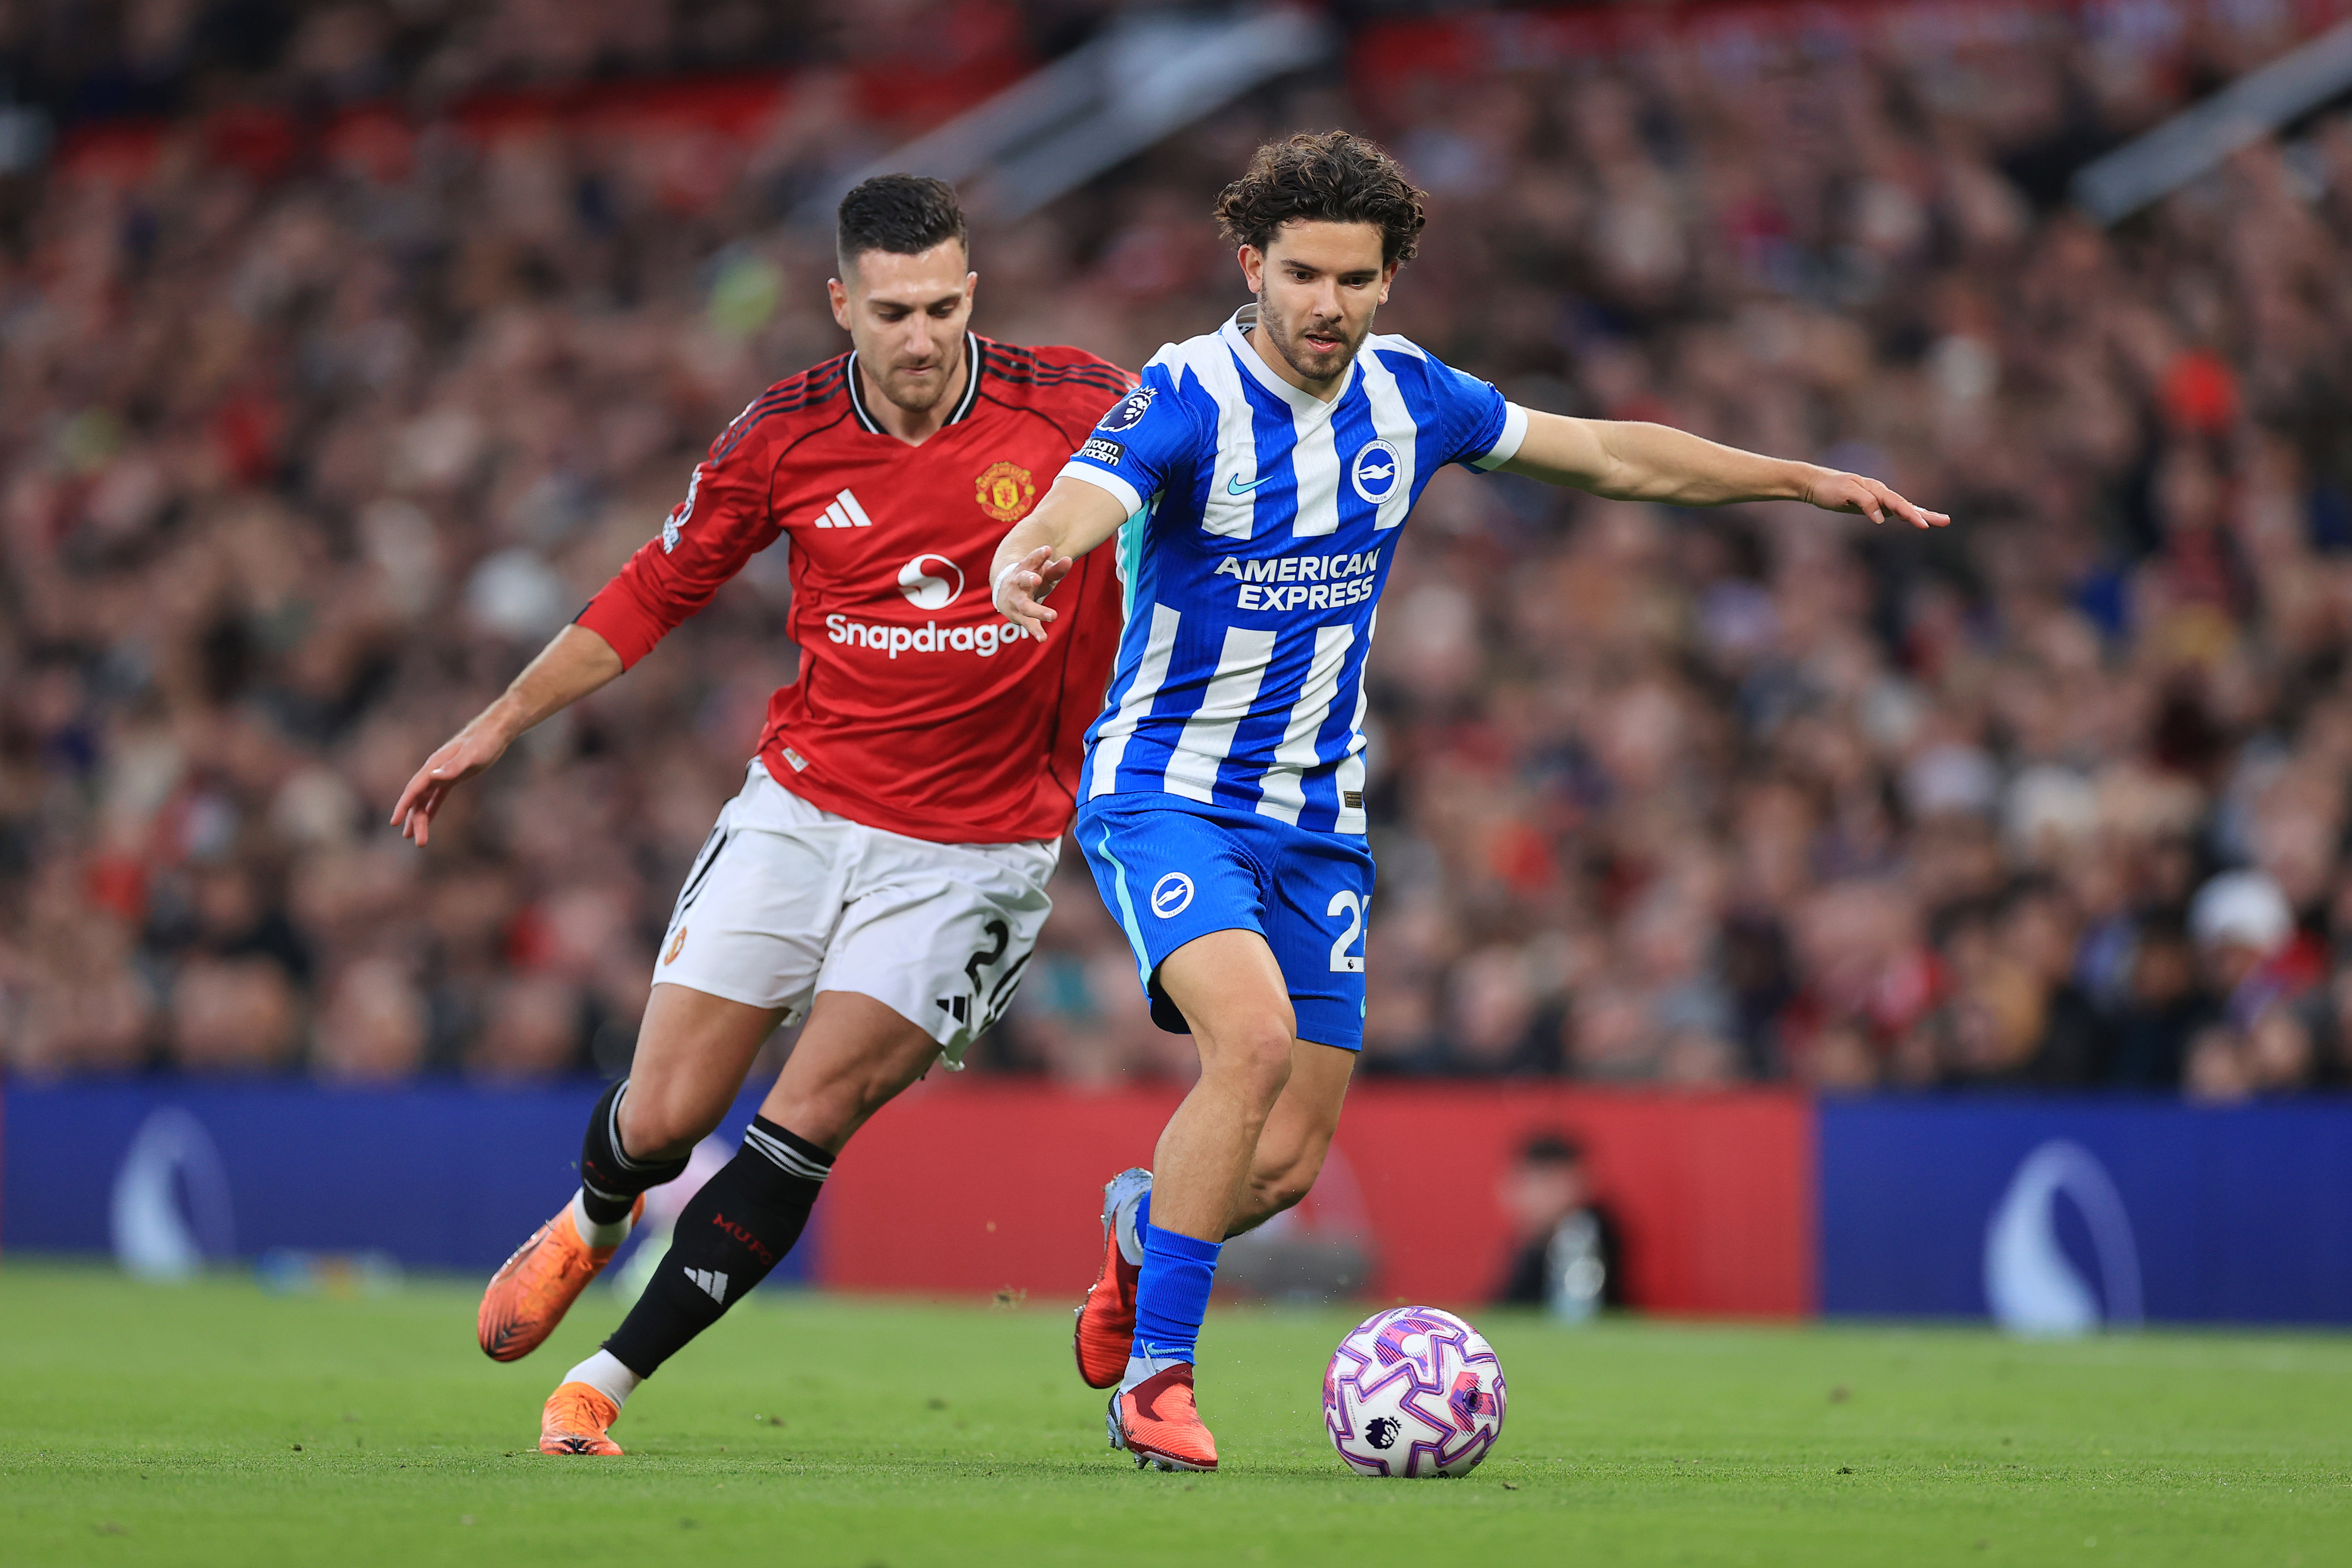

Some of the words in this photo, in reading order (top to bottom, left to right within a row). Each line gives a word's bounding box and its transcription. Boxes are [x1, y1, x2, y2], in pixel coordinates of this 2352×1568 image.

[1082, 448, 1119, 466] racism
[1089, 440, 1119, 455] room
[1358, 442, 1379, 460] BRIGHTON
[1385, 444, 1396, 457] HOVE
[1213, 548, 1381, 583] AMERICAN
[1237, 575, 1375, 611] EXPRESS
[1327, 890, 1371, 972] 2
